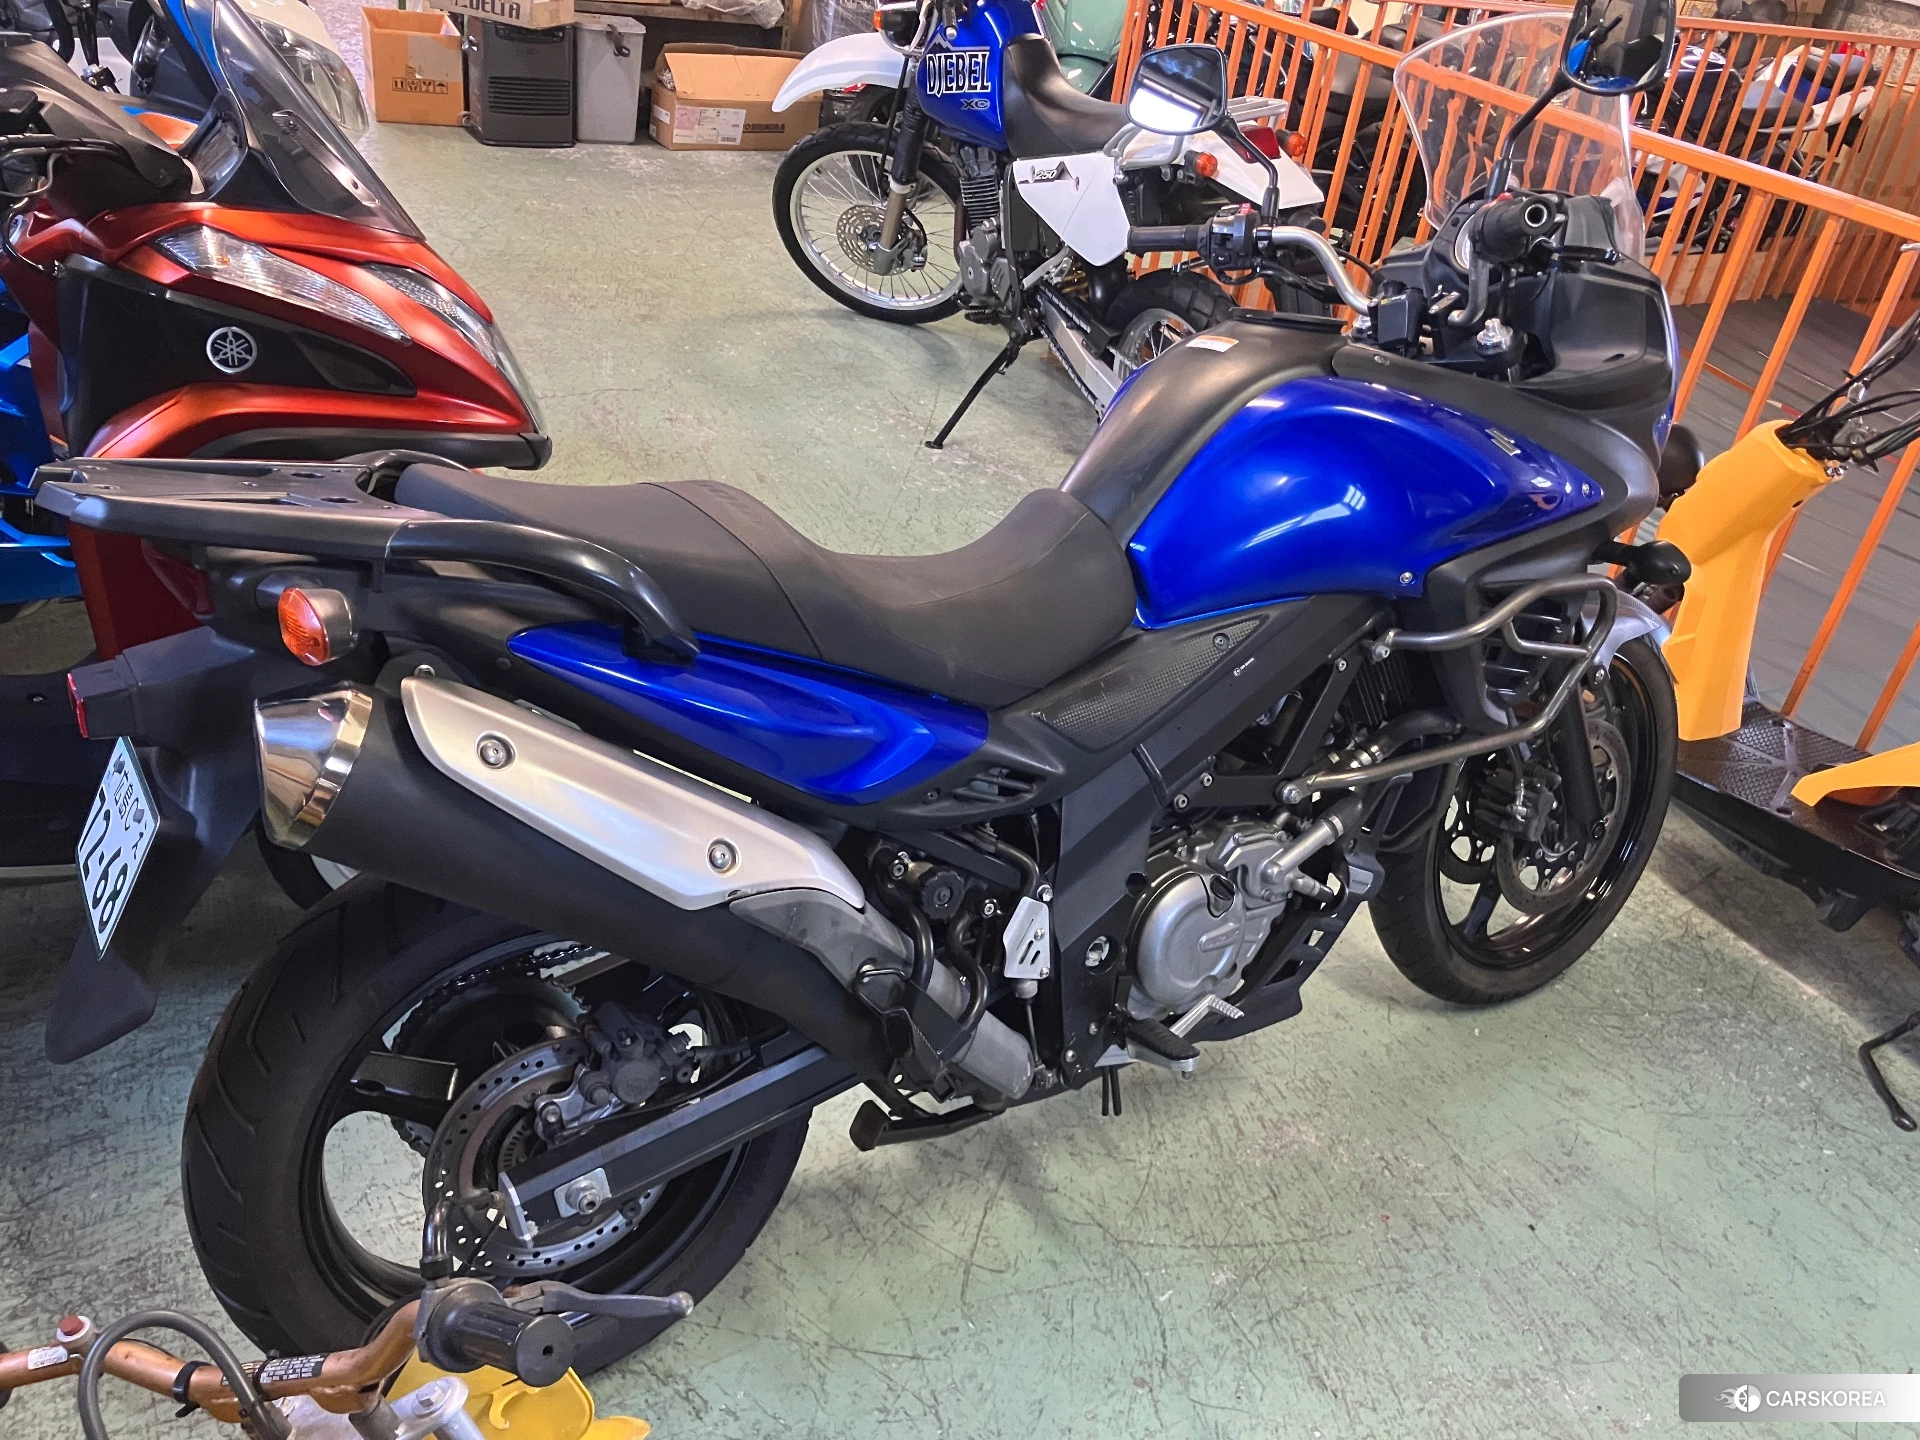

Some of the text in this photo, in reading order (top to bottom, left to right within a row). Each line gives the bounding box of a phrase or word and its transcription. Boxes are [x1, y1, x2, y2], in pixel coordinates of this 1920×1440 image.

[926, 52, 991, 97] DJEBEL
[960, 98, 990, 110] XC
[1035, 169, 1057, 180] 250
[79, 785, 128, 935] 72-68
